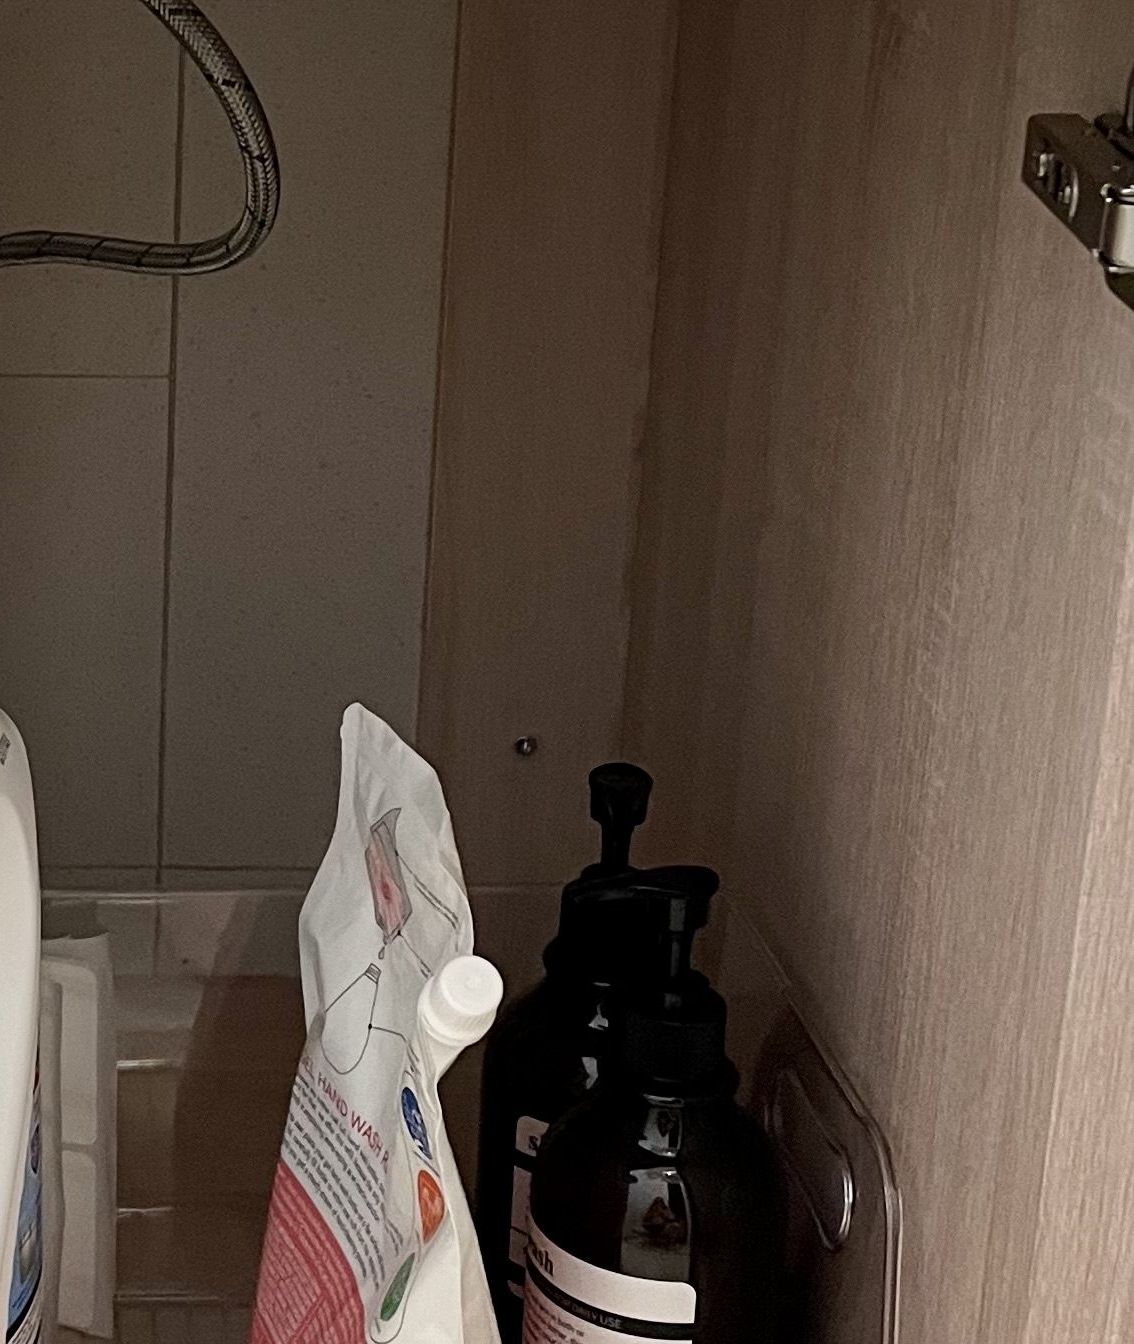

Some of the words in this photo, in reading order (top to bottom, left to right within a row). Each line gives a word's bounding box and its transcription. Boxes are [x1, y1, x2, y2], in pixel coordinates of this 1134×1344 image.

[317, 1071, 348, 1116] HAND
[350, 1111, 384, 1158] WASH
[599, 1314, 623, 1330] USE
